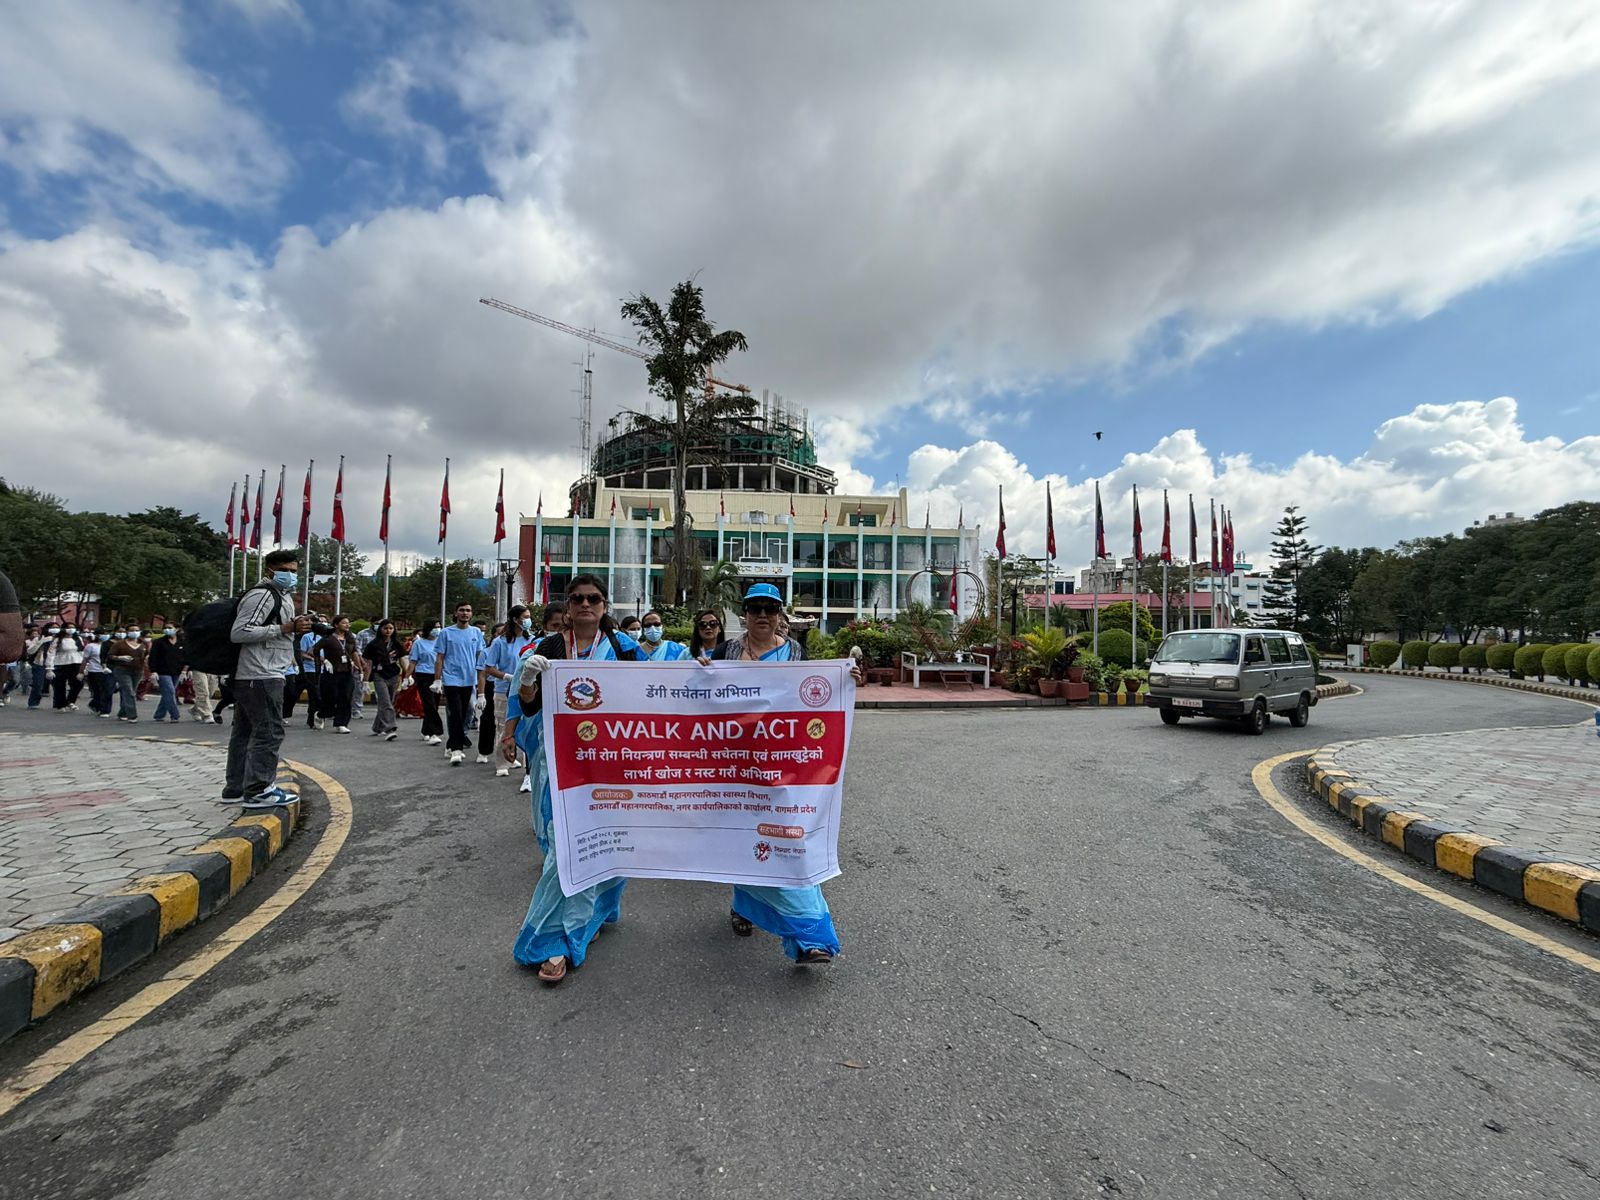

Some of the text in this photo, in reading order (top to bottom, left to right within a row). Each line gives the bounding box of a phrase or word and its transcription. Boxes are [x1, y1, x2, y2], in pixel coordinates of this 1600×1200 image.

[646, 684, 761, 699] डेंगी सचेतना अभियान
[605, 719, 799, 740] WALK AND ACT
[600, 748, 617, 760] रोग
[621, 747, 665, 760] नियन्त्रण
[669, 747, 707, 760] सम्बन्धी
[711, 747, 749, 759] सचेतना
[752, 749, 768, 763] एवं
[771, 746, 823, 763] लामखुट्टेको
[624, 766, 652, 779] लार्भा
[655, 765, 681, 779] खोज
[685, 768, 691, 778] र
[740, 766, 782, 780] अभियान
[668, 789, 720, 800] महानगरपालिका
[676, 803, 691, 811] नगर
[801, 803, 817, 813] प्रदेश
